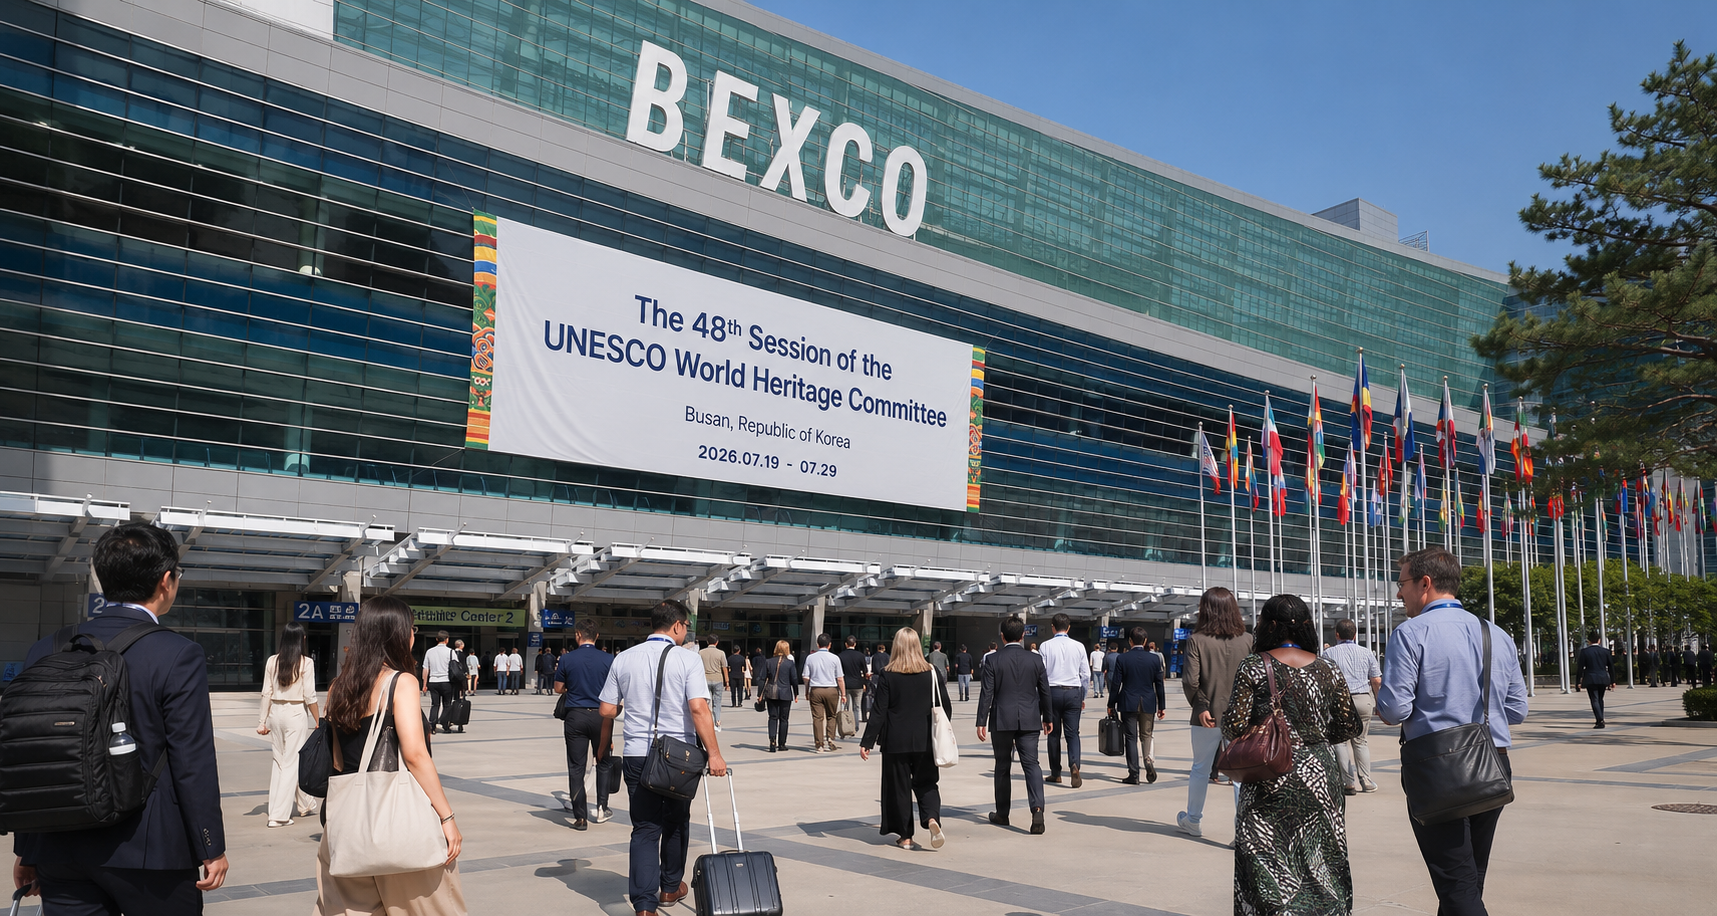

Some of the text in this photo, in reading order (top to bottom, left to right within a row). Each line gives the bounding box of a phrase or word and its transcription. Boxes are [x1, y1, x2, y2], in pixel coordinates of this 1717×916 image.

[626, 40, 928, 237] BEXCO
[635, 295, 893, 381] The 48th Session of the
[545, 320, 947, 428] UNESCO World Heritage Committee
[685, 406, 851, 449] Busan, Republic of Korea
[698, 445, 780, 470] 2026.07.19
[800, 461, 837, 478] 07.29
[298, 603, 324, 620] 2A
[505, 611, 514, 624] 2
